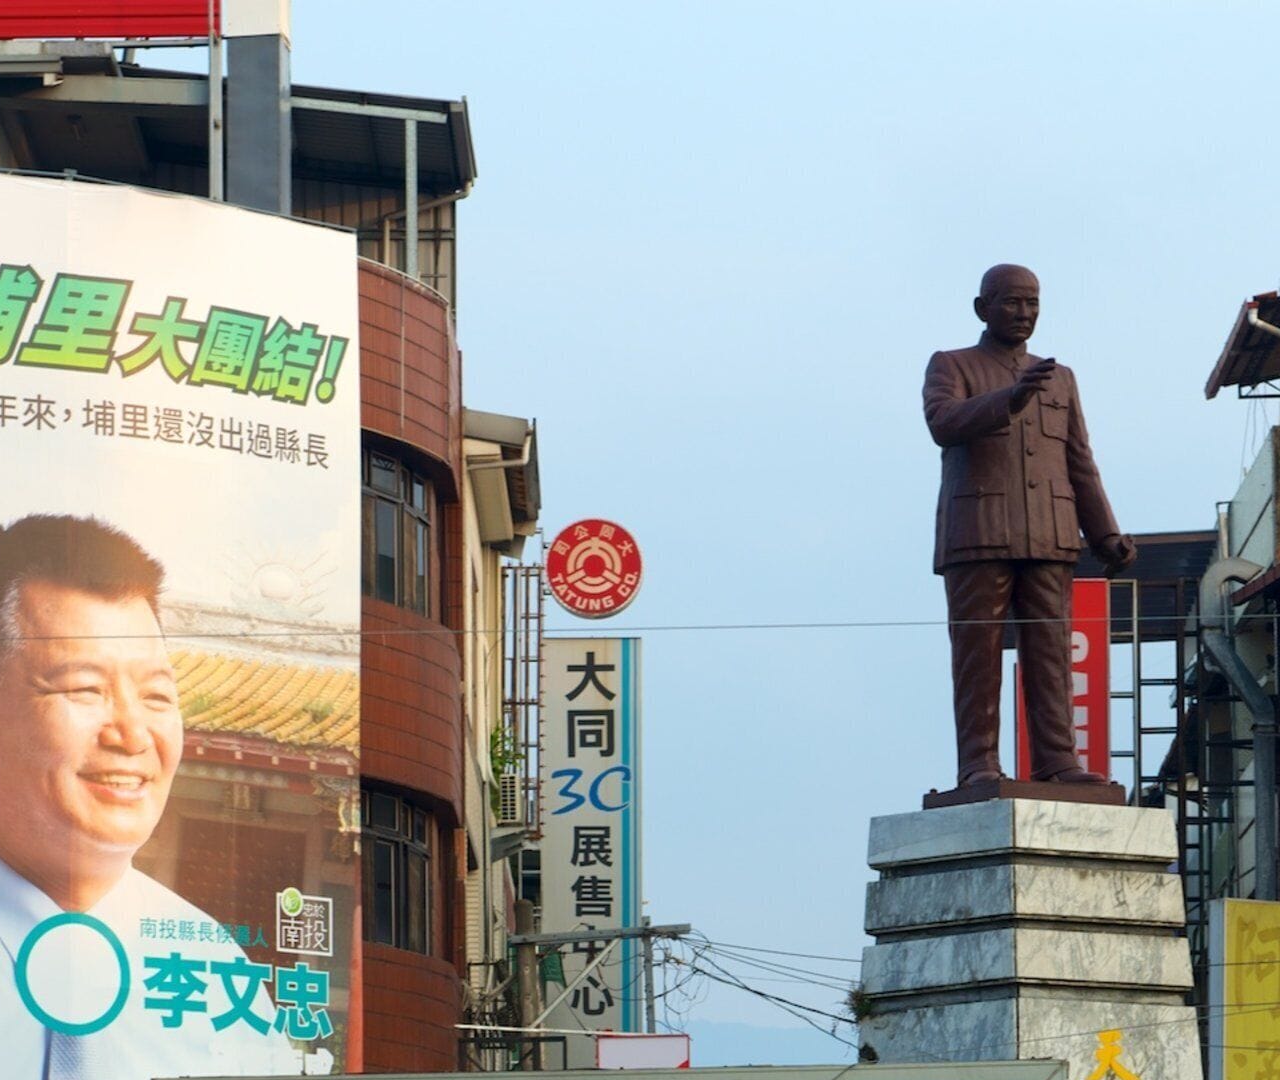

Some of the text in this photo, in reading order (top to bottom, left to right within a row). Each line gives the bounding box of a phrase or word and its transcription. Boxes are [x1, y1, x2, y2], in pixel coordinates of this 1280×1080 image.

[551, 572, 615, 611] TATUNG
[139, 916, 269, 949] 南投縣長候選人
[280, 916, 329, 952] 南投
[142, 951, 334, 1041] 李文忠
